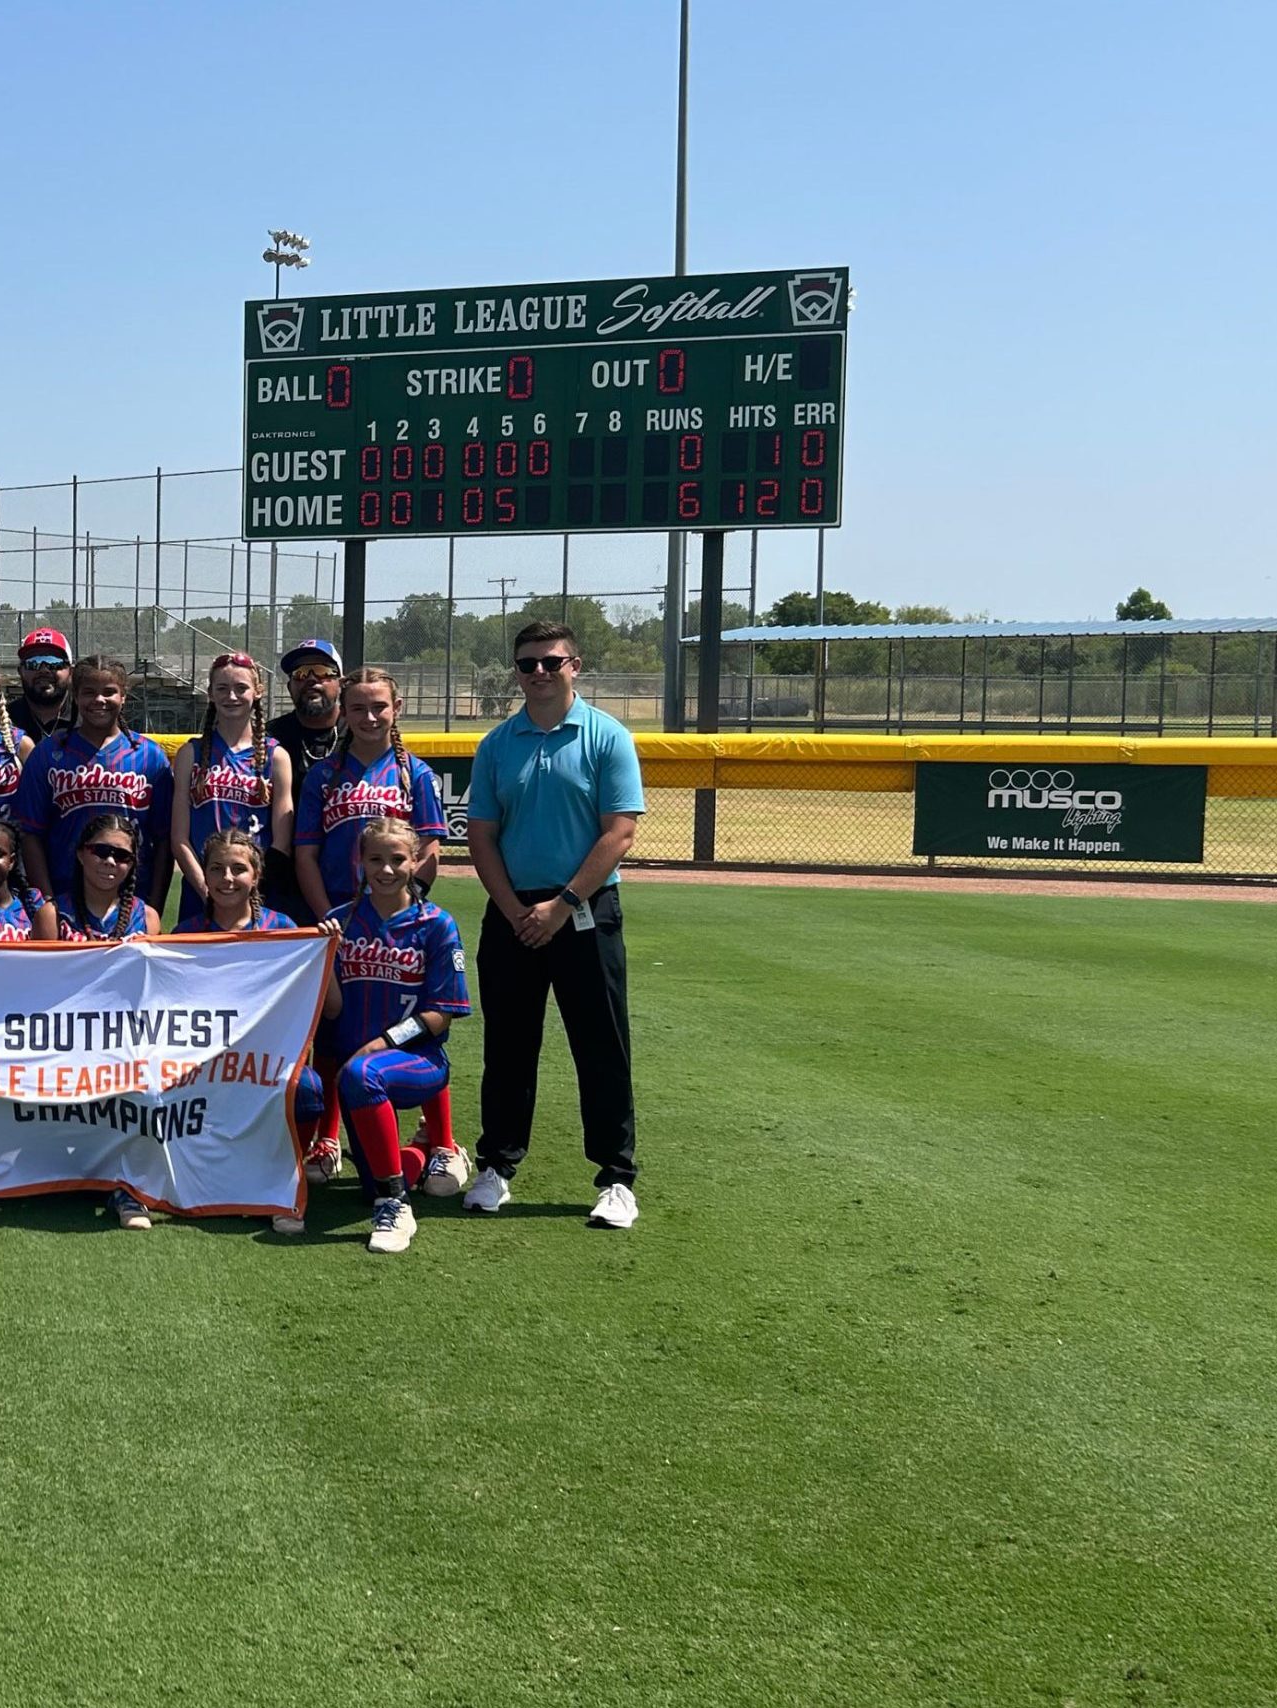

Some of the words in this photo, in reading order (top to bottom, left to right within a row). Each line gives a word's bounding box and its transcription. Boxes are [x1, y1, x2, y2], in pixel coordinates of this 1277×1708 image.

[320, 302, 436, 342] LITTLE
[454, 294, 587, 334] LEAGUE
[596, 283, 777, 335] Softball
[257, 375, 323, 403] BALL
[327, 365, 351, 408] 0
[406, 366, 502, 397] STRIKE
[508, 356, 533, 399] 0
[591, 359, 650, 388] OUT
[659, 349, 685, 393] 0
[744, 353, 793, 384] H/E
[251, 430, 317, 440] DAKTRONICS
[366, 421, 378, 442] 1
[396, 420, 409, 441] 2
[428, 418, 441, 440] 3
[466, 417, 479, 438] 4
[500, 415, 514, 437] 5
[533, 413, 547, 435] 6
[575, 412, 589, 434] 7
[608, 410, 622, 432] 8
[646, 407, 703, 431] RUNS
[729, 404, 777, 428] HITS
[793, 402, 836, 426] ERR
[251, 449, 346, 483] GUEST
[361, 446, 381, 481] 0
[393, 446, 413, 480] 0
[424, 445, 444, 478] 0
[463, 443, 484, 477] 0
[496, 442, 517, 476] 0
[529, 441, 549, 476] 0
[680, 435, 702, 470] 0
[802, 430, 824, 466] 0
[252, 494, 343, 527] HOME
[360, 491, 380, 526] 0
[391, 491, 412, 525] 0
[463, 488, 484, 524] 0
[496, 488, 516, 523] 5
[679, 482, 700, 518] 6
[738, 480, 780, 516] 12
[801, 477, 822, 514] 0
[48, 763, 153, 801] Midway
[60, 793, 80, 812] ALL
[83, 790, 126, 804] STARS
[212, 786, 250, 803] STARS
[325, 809, 345, 826] ALL
[347, 803, 388, 816] STARS
[987, 836, 1008, 850] We
[1012, 837, 1050, 851] Make
[1054, 837, 1065, 851] It
[1068, 838, 1120, 854] Happen
[359, 963, 402, 981] STARS
[400, 994, 418, 1020] 7
[4, 1009, 238, 1051] SOUTHWEST
[37, 1060, 150, 1098] LEAGUE
[161, 1051, 285, 1092] SOFTBALL
[13, 1097, 208, 1145] CHAMPIONS
